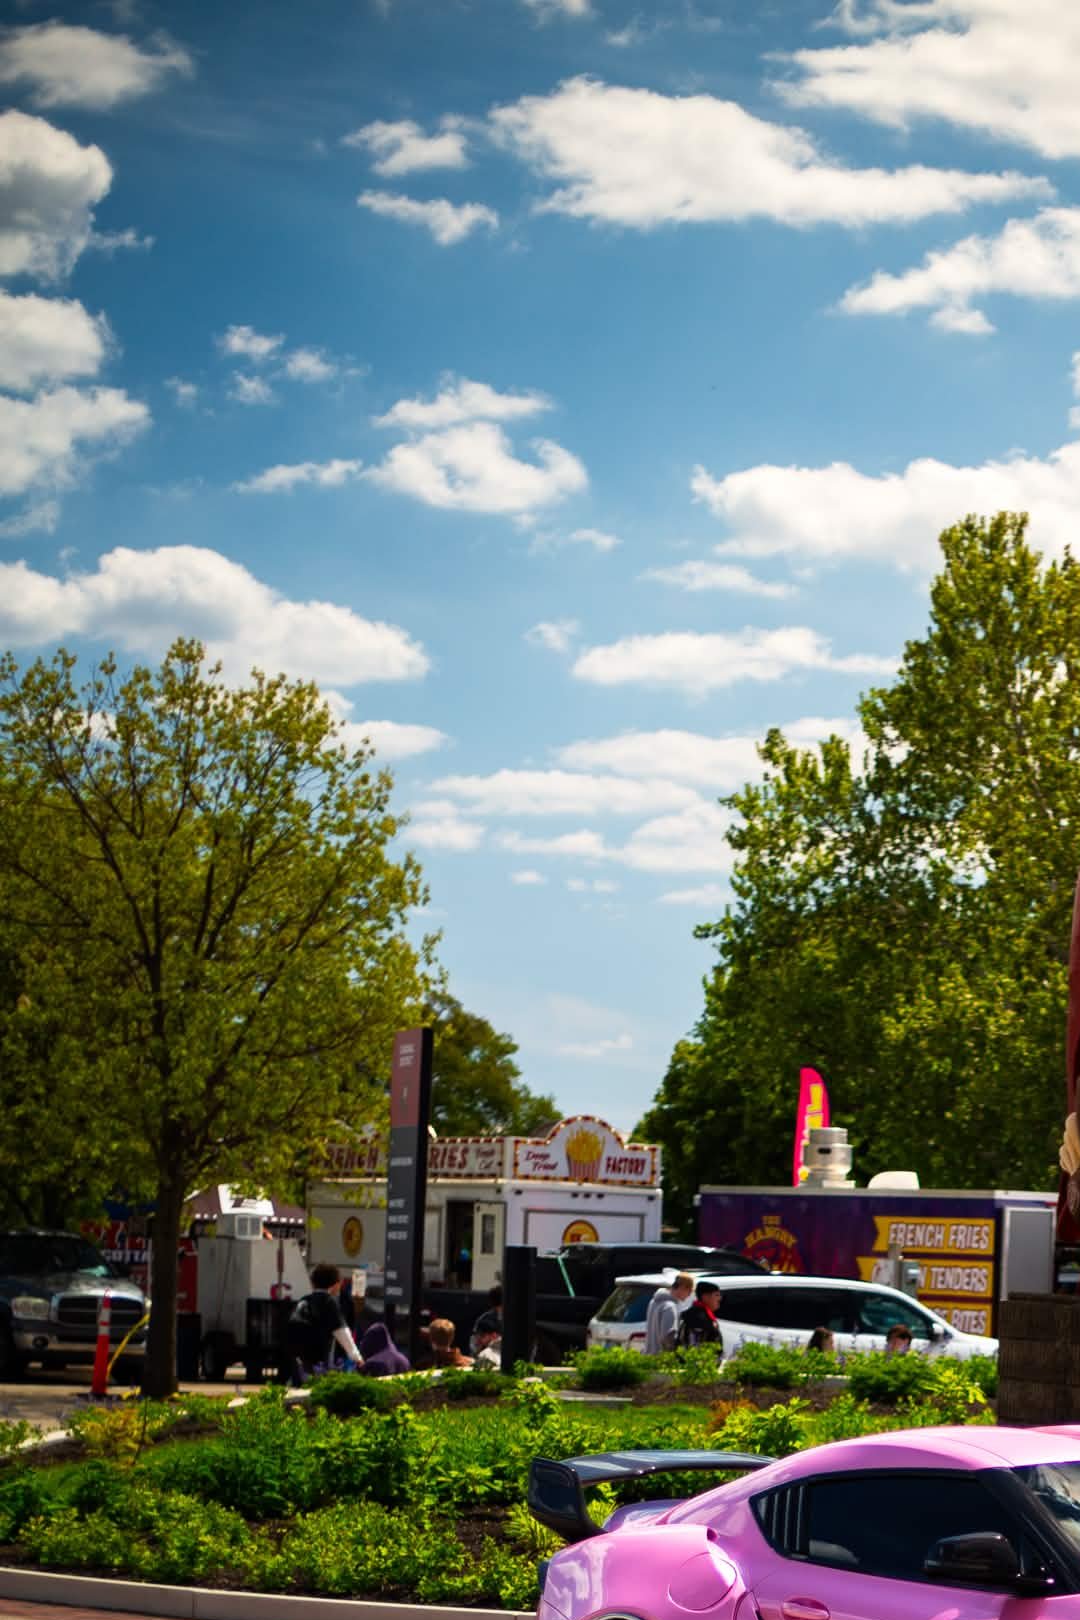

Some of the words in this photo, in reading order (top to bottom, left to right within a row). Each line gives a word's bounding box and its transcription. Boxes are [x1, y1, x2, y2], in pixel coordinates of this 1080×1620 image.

[429, 1147, 469, 1170] RIES
[605, 1156, 647, 1176] FACTORY
[888, 1222, 945, 1248] FRENCH
[948, 1225, 990, 1250] FRIES
[929, 1266, 989, 1293] TENDERS
[950, 1308, 988, 1335] BITES
